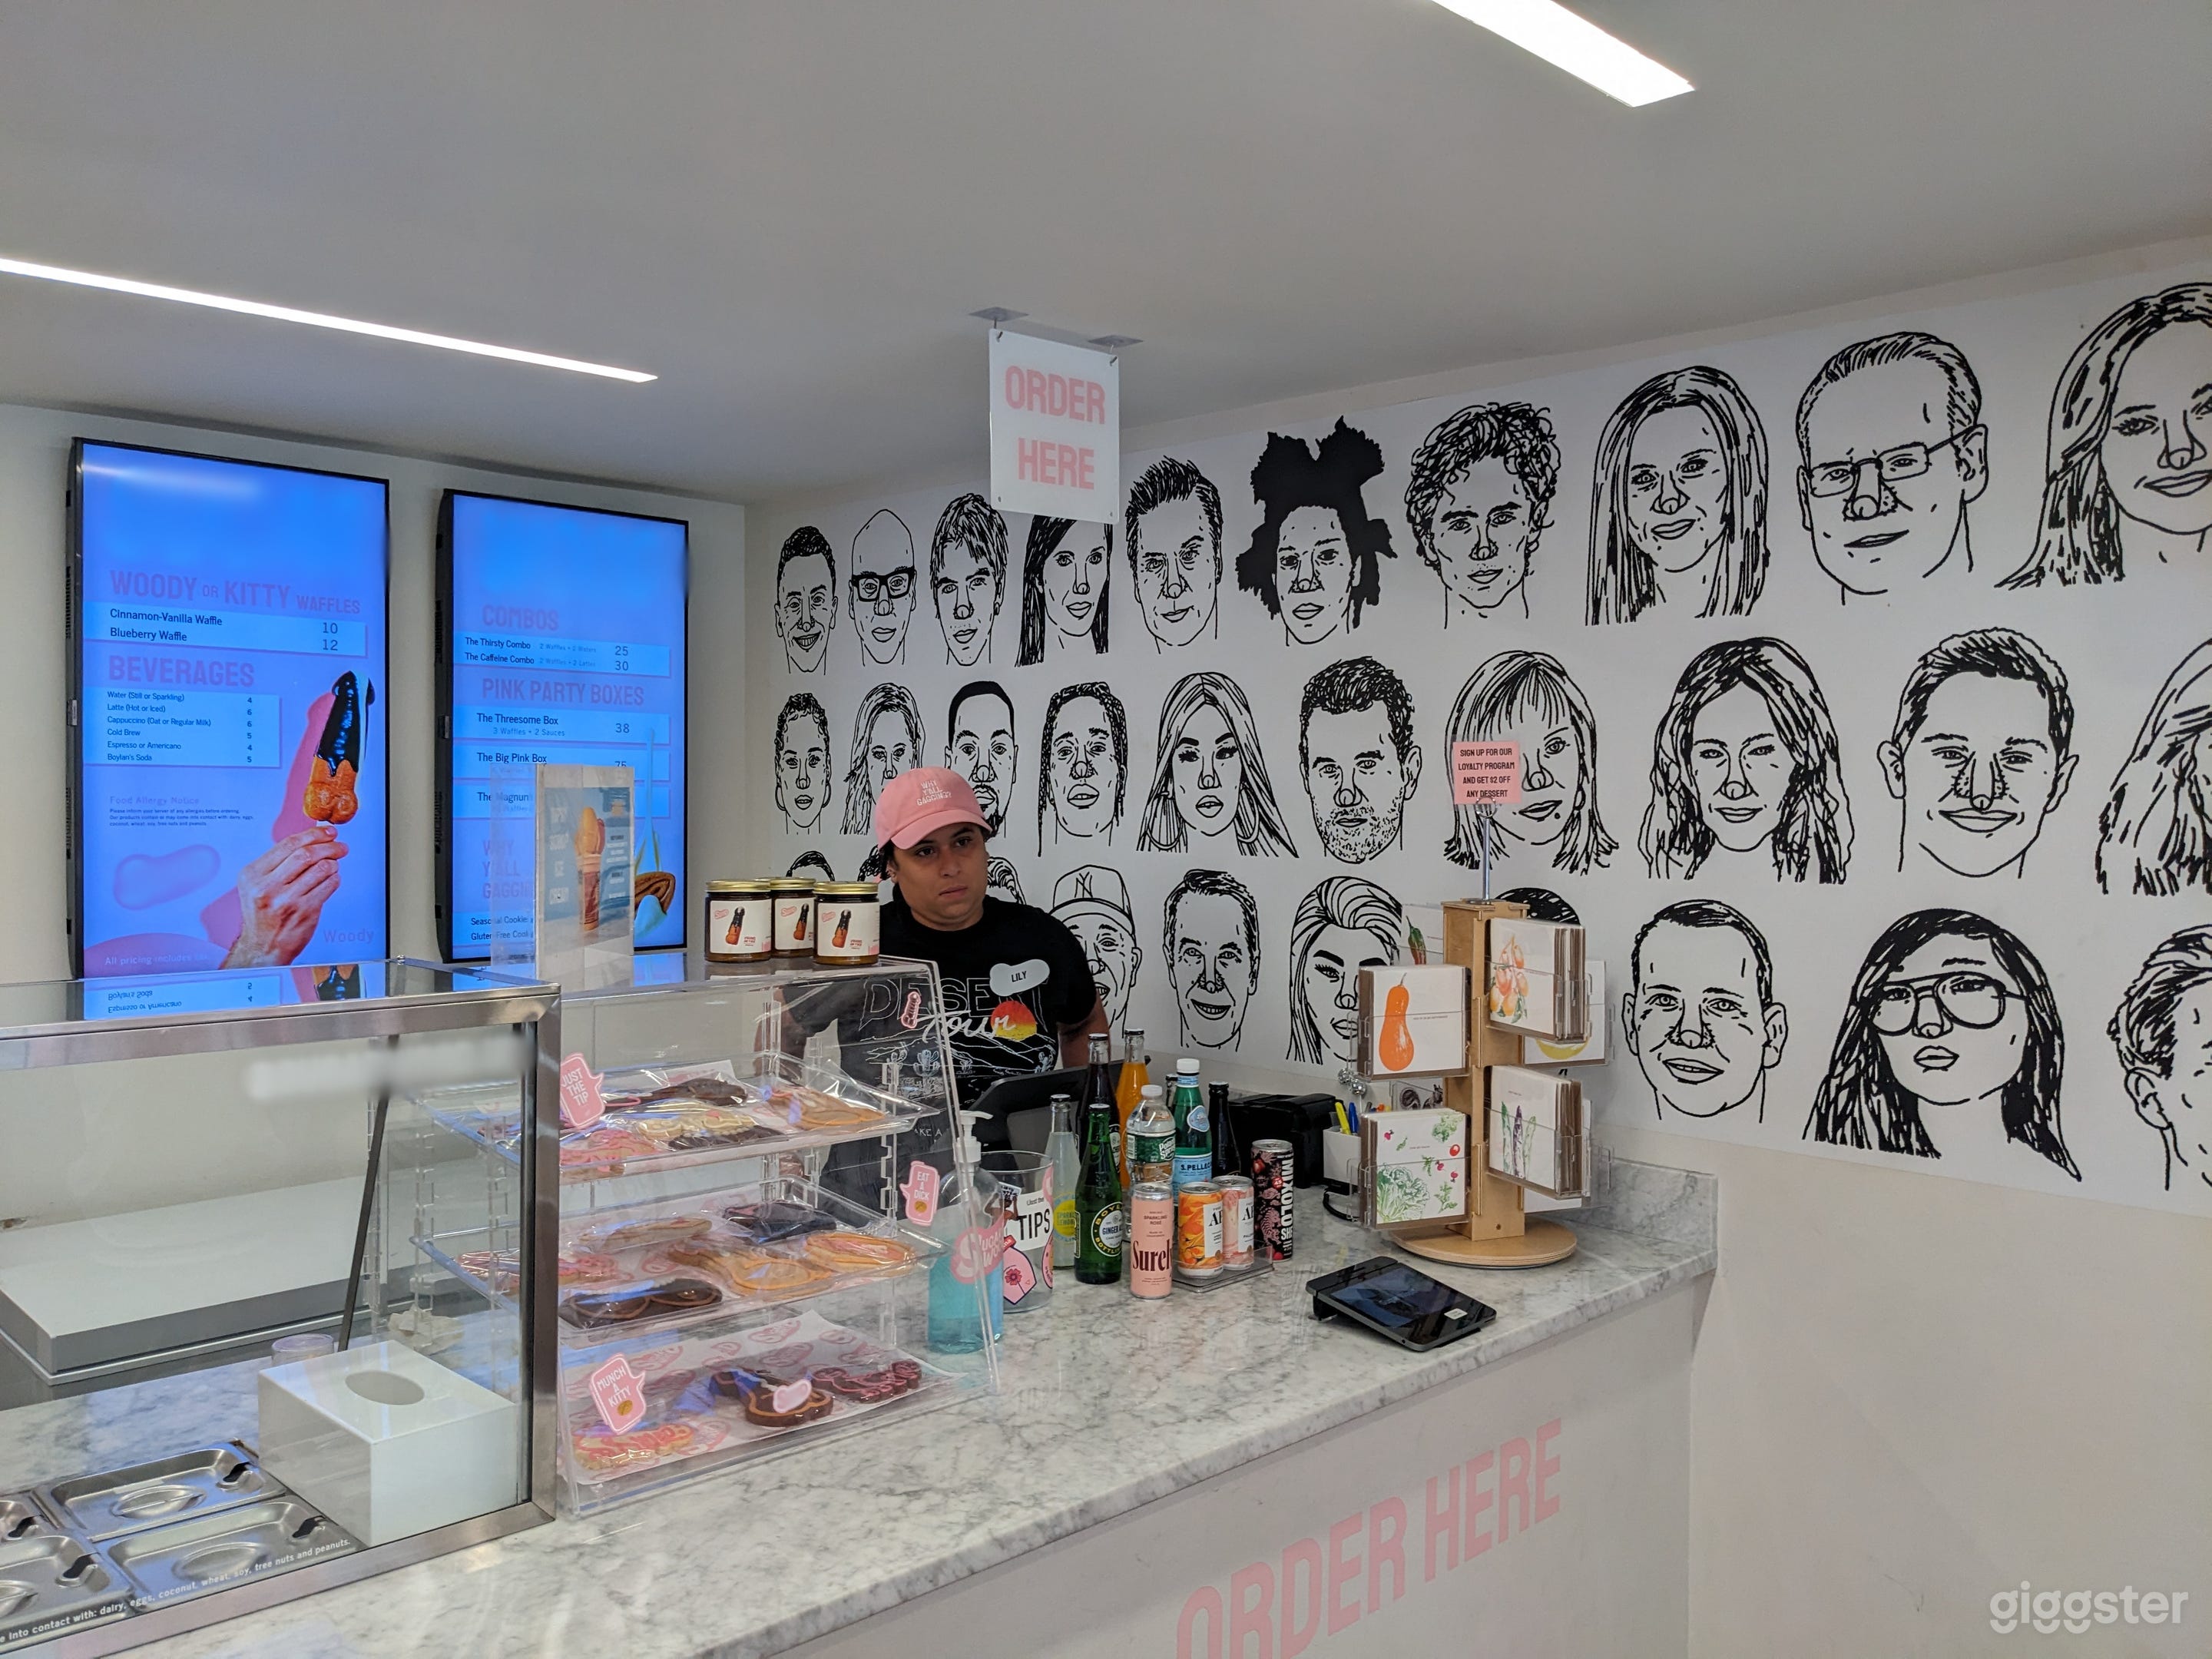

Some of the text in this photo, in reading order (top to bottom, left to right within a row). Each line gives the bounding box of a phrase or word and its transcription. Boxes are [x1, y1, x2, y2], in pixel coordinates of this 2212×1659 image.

[1005, 365, 1105, 425] ORDER
[1018, 437, 1094, 490] HERE
[110, 570, 360, 614] WOODY OR KITTY WAFFLES
[110, 608, 338, 634] Cinnamon-Vanilla Waffle 10
[482, 604, 559, 631] COMBOS
[110, 627, 338, 651] Blueberry Waffle 12
[465, 637, 478, 646] The
[480, 638, 504, 649] Thirsty
[505, 641, 531, 650] Combo
[615, 645, 628, 656] 25
[465, 652, 478, 661] The
[481, 654, 508, 663] Caffeine
[510, 655, 535, 664] Combo
[615, 661, 629, 671] 30
[109, 655, 255, 687] BEVERAGES
[152, 693, 184, 702] Sparkling)
[482, 678, 644, 706] PINK PARTY BOXES
[126, 704, 140, 712] (Hot
[108, 716, 146, 725] Cappuccino
[147, 717, 161, 725] (Oat
[171, 718, 194, 727] Regular
[196, 718, 211, 727] Milk)
[476, 713, 630, 733] The Threesome Box 38
[501, 727, 526, 736] Waffles
[108, 741, 137, 750] Espresso
[476, 752, 493, 762] The
[495, 753, 509, 763] Big
[512, 753, 529, 763] Pink
[532, 753, 547, 763] Box
[1458, 762, 1515, 770] LOYALTY PROGRAM
[921, 780, 937, 789] WHY
[1476, 776, 1489, 784] GET
[476, 791, 492, 802] The
[916, 791, 952, 806] GAGGING?
[1466, 790, 1508, 798] ANY DESSERT
[323, 928, 375, 945] Woody
[104, 956, 117, 965] All
[120, 955, 153, 966] pricing
[1011, 971, 1027, 982] LILY
[859, 976, 1048, 1032] DESET
[561, 1068, 583, 1088] JUST
[566, 1080, 586, 1097] THE
[573, 1091, 588, 1106] TIP
[917, 1171, 929, 1181] EAT
[919, 1181, 924, 1190] A
[914, 1190, 929, 1200] DICK
[1017, 1208, 1050, 1240] TIPS
[1102, 1226, 1118, 1235] GINGER
[597, 1365, 627, 1391] MUNCH
[613, 1383, 620, 1393] A
[608, 1386, 631, 1407] KITTY
[1176, 1418, 1562, 1659] ORDER HERE
[9, 1630, 29, 1641] into
[31, 1618, 71, 1634] contact
[73, 1609, 98, 1624] with:
[100, 1602, 126, 1616] dairy,
[254, 1560, 273, 1571] tree
[275, 1554, 294, 1565] nuts
[296, 1548, 313, 1559] and
[314, 1538, 351, 1555] peanuts.
